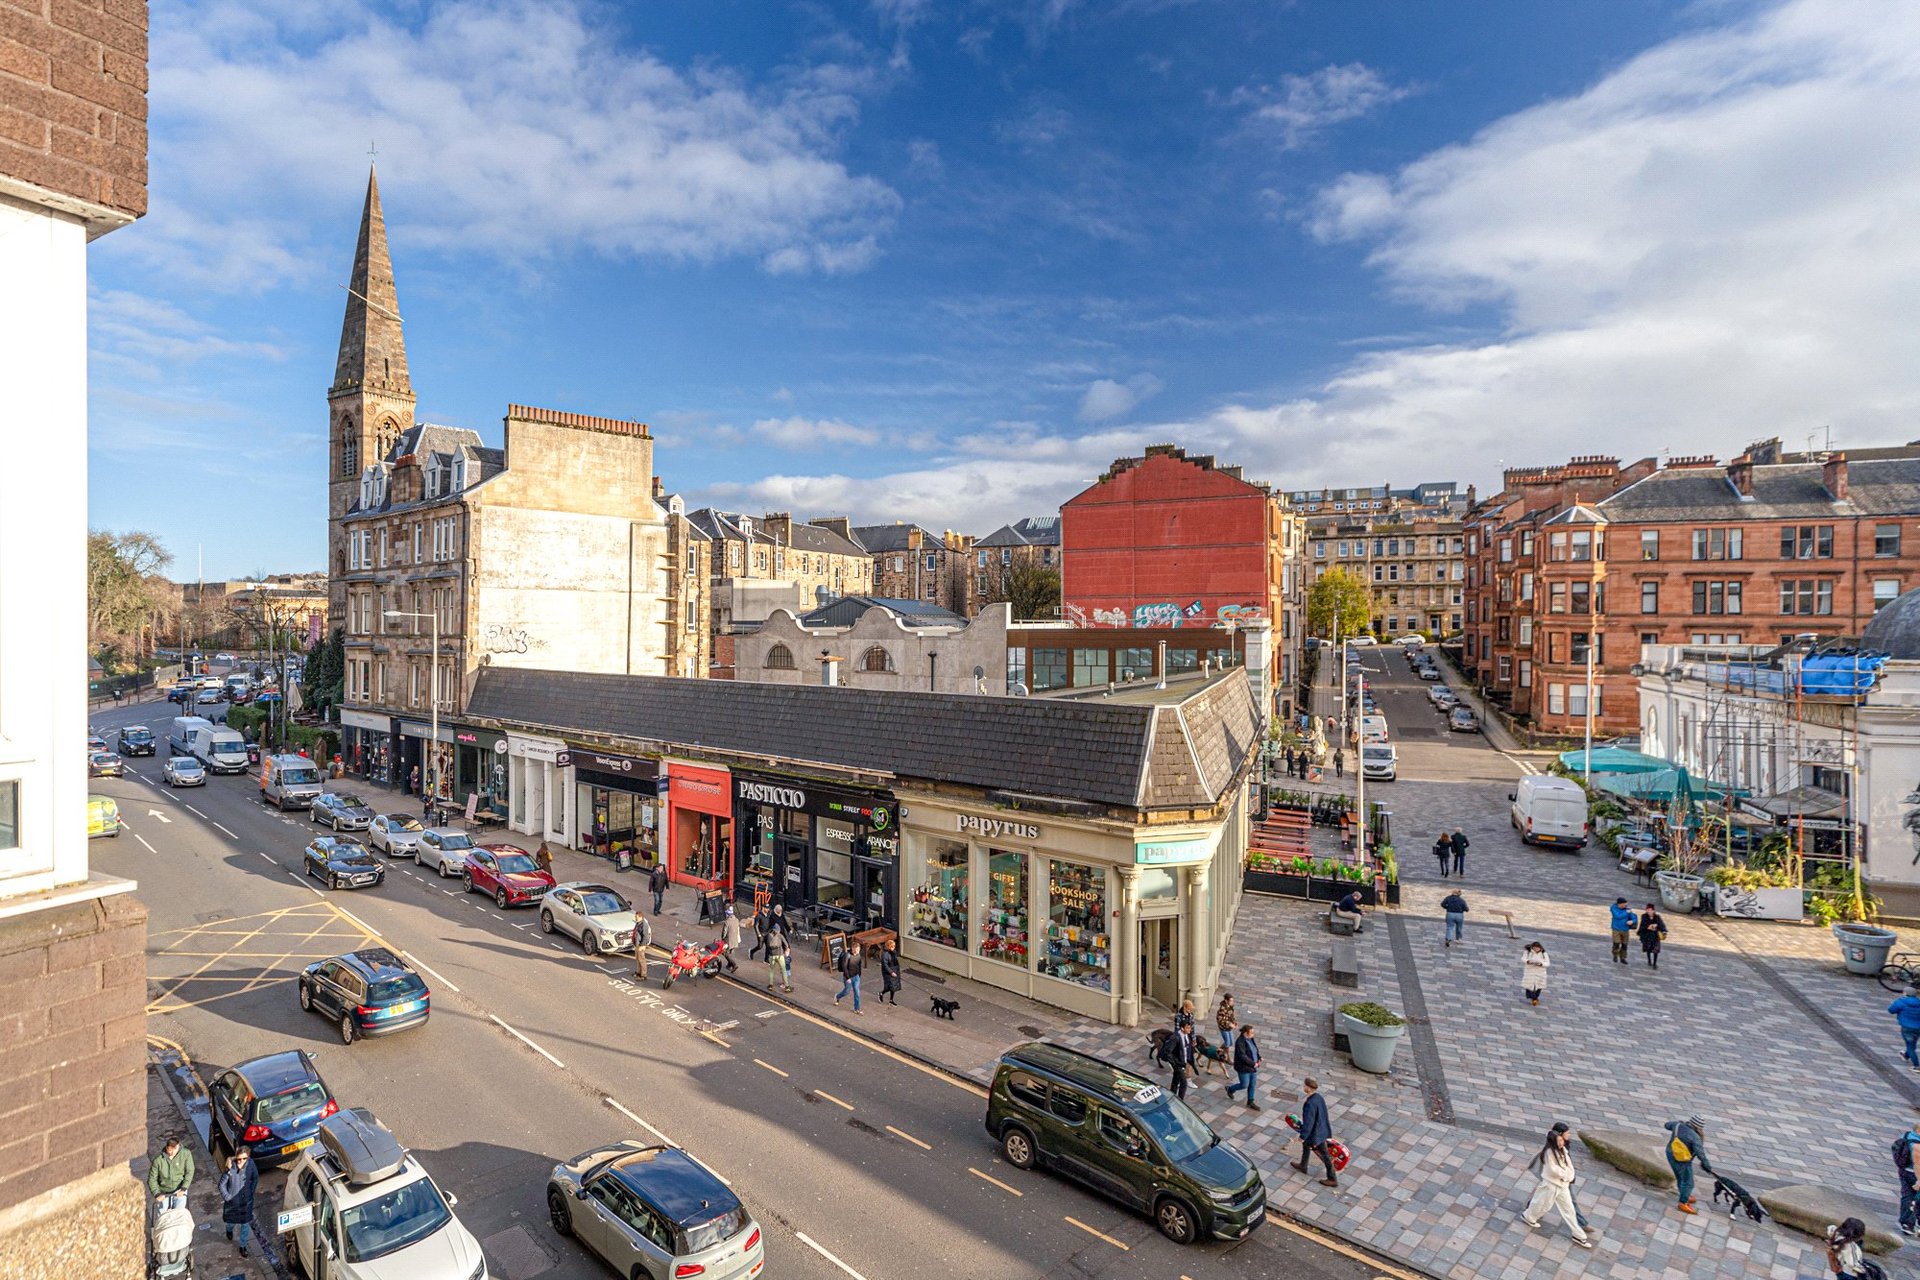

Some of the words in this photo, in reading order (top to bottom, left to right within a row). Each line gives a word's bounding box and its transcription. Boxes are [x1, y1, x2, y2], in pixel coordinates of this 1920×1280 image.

[739, 781, 806, 808] PASTICCIO
[955, 813, 1040, 839] papyrus
[1143, 844, 1206, 860] papyrus
[1062, 897, 1085, 909] SALE
[608, 979, 642, 996] SOLO
[661, 1007, 697, 1025] ONLY
[1141, 1086, 1159, 1099] TAXI
